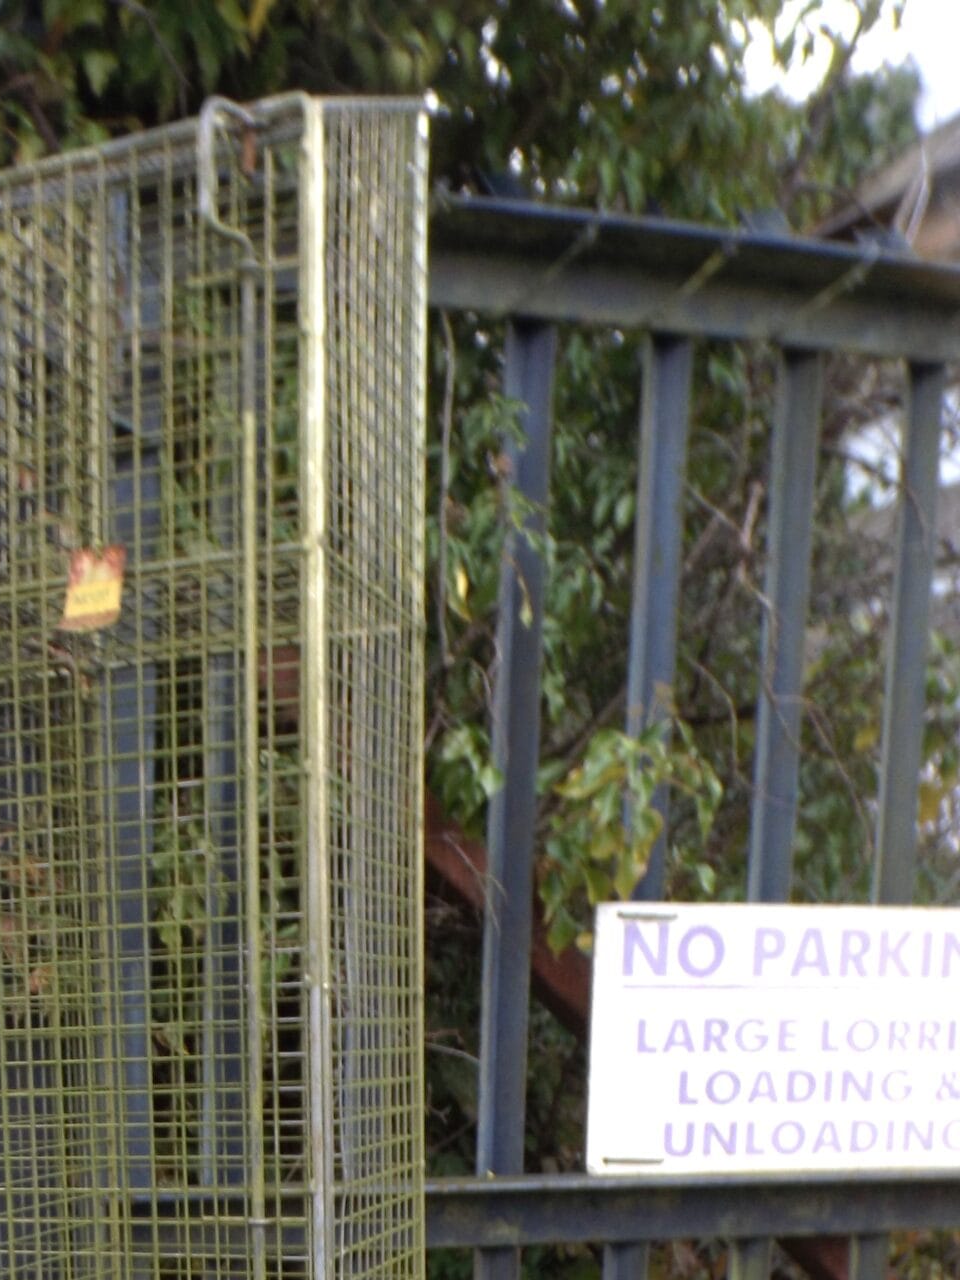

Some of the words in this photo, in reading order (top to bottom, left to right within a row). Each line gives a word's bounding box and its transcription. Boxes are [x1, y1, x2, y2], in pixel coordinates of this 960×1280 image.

[622, 922, 725, 977] NO
[638, 1019, 796, 1052] LARGE
[821, 1019, 957, 1052] LORRI
[679, 1070, 912, 1104] LOADING
